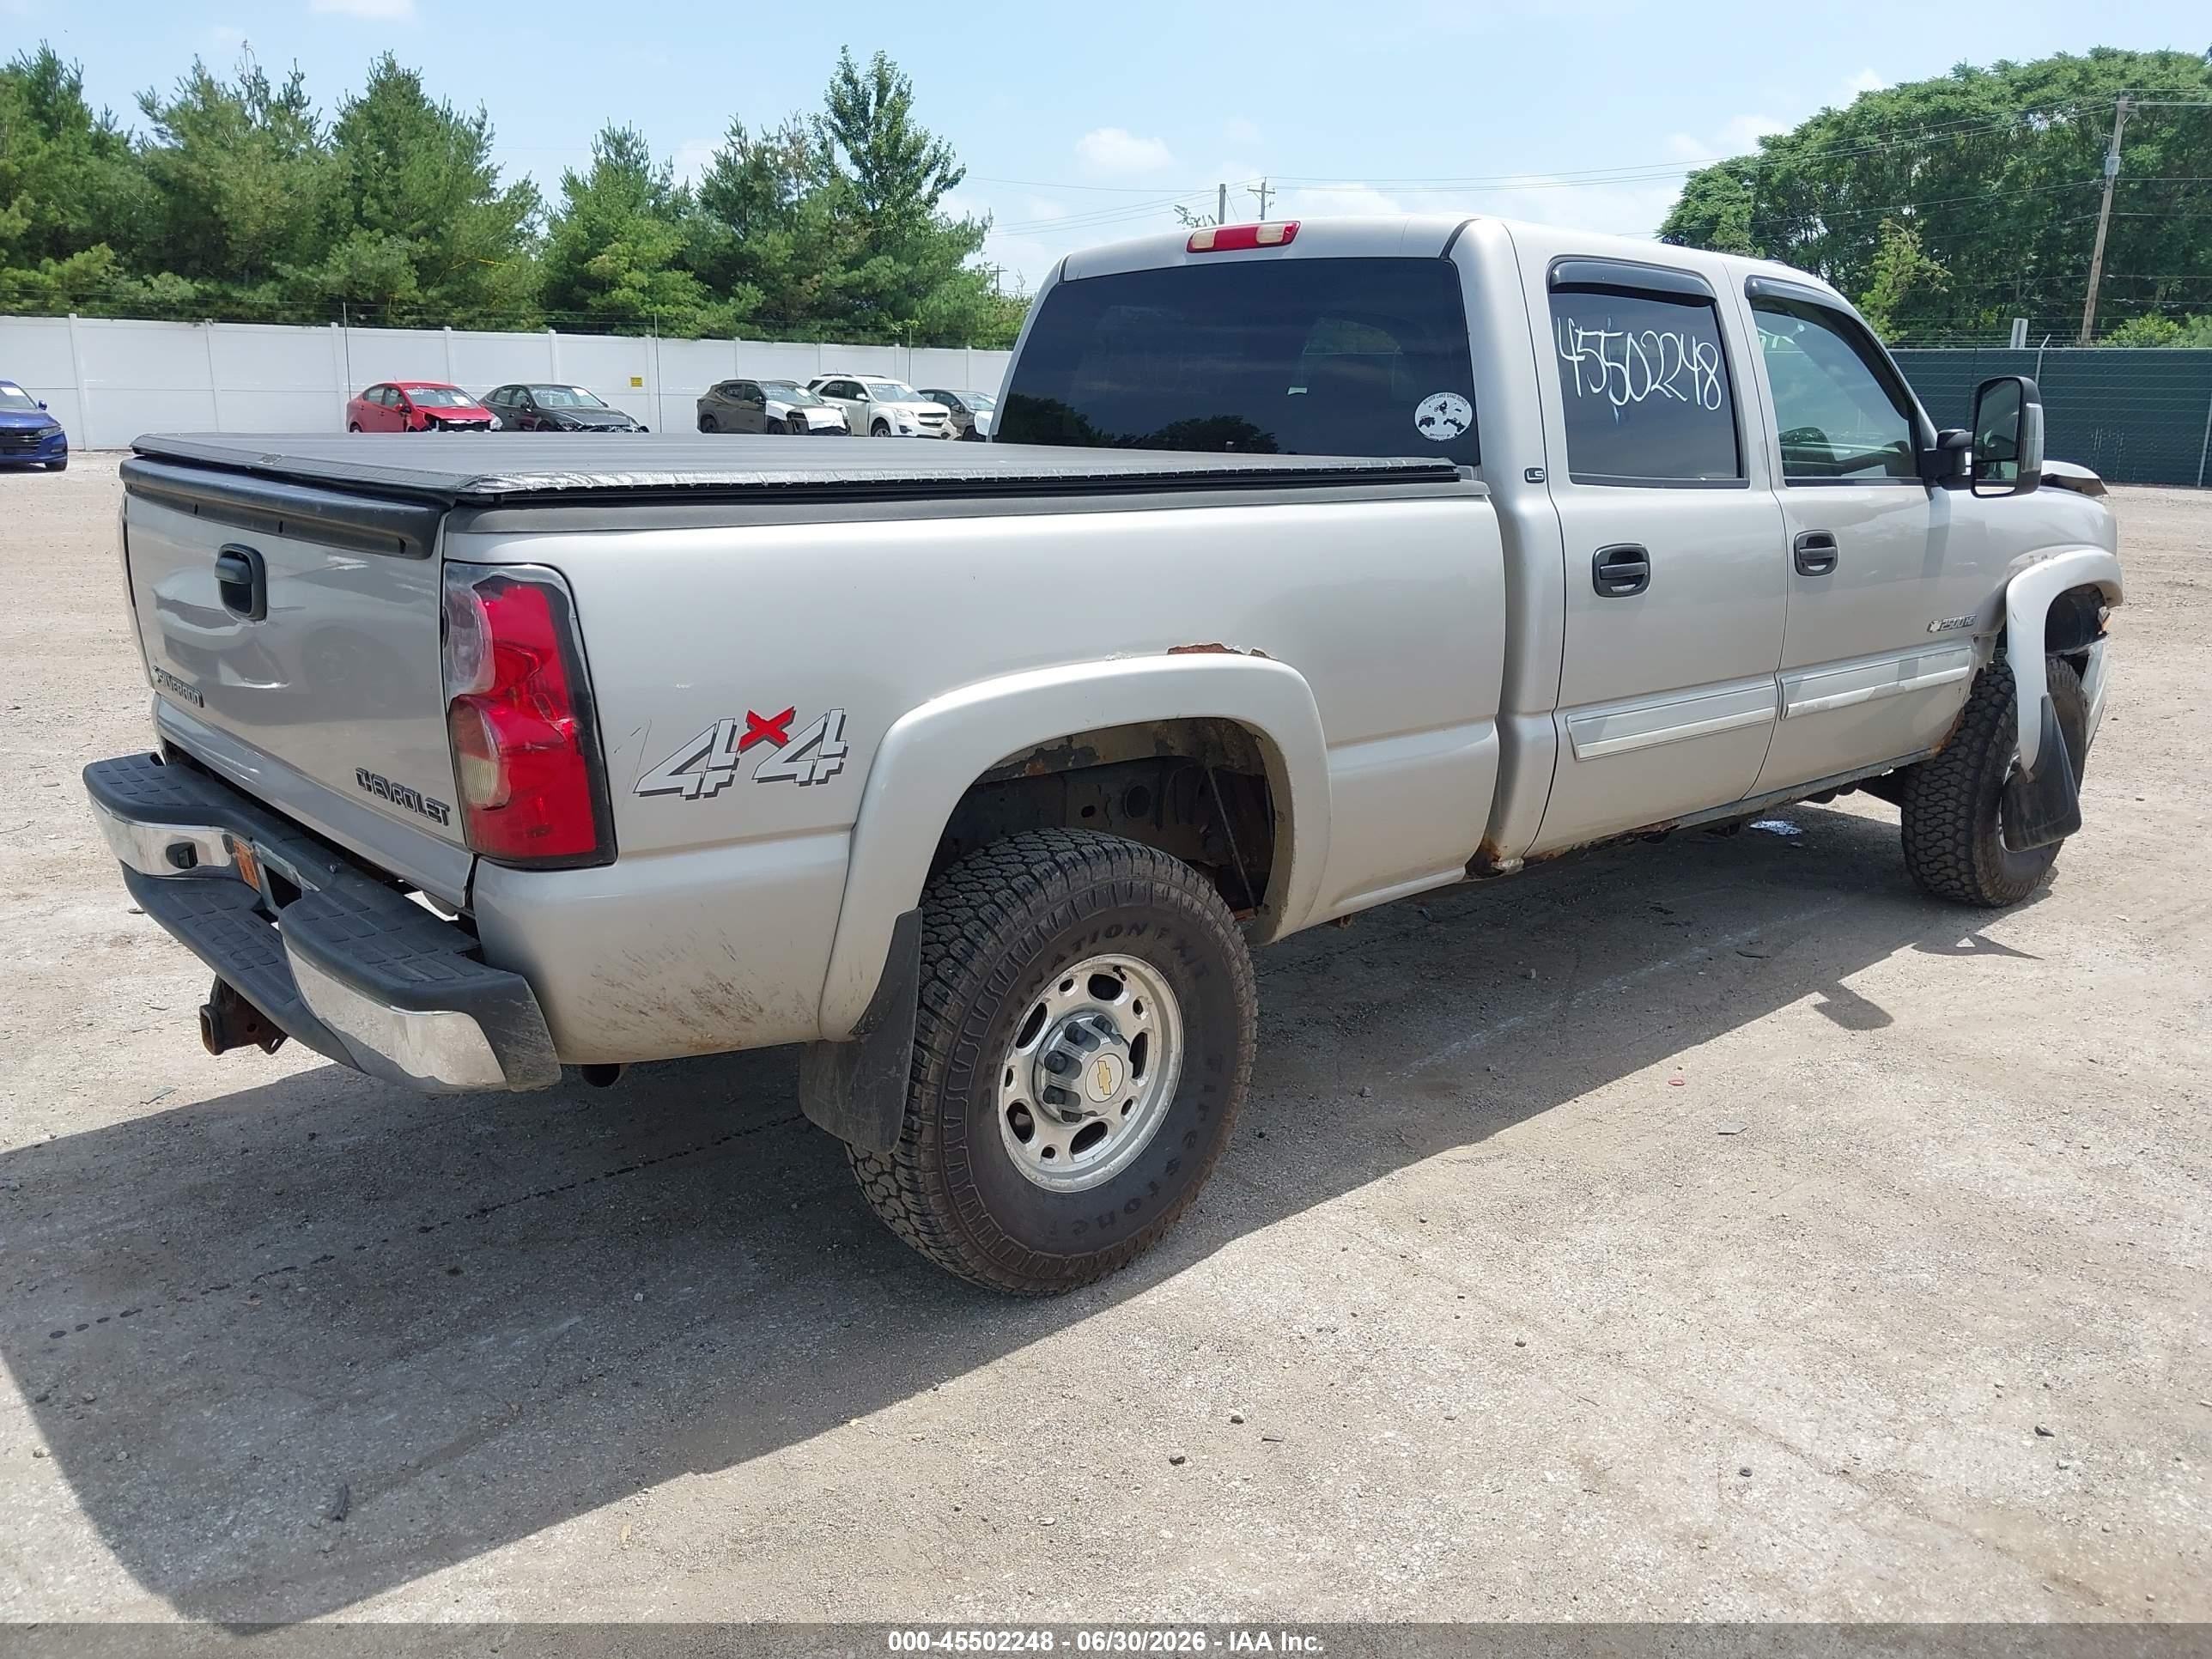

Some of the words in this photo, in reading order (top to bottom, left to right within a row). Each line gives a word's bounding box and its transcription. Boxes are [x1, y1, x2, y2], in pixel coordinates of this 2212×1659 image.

[1557, 317, 1722, 410] 45502248
[1526, 470, 1544, 480] LS
[155, 668, 204, 708] SILVERADO
[355, 767, 451, 826] CHEVROLET
